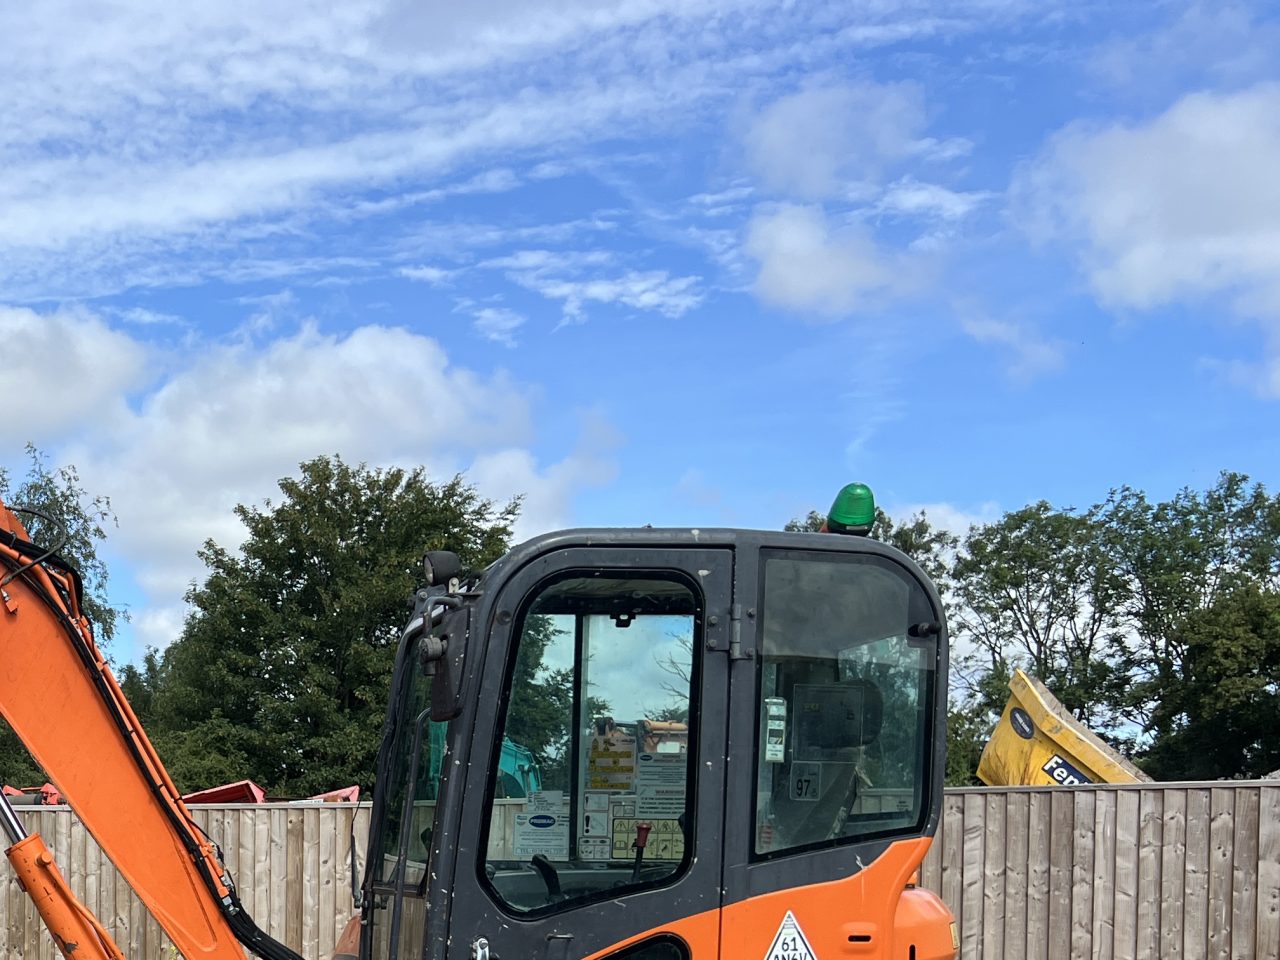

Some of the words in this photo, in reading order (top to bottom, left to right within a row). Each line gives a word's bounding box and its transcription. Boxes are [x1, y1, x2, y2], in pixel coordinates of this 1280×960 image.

[1043, 755, 1089, 786] Fen
[796, 778, 811, 797] 97
[781, 936, 799, 952] 61
